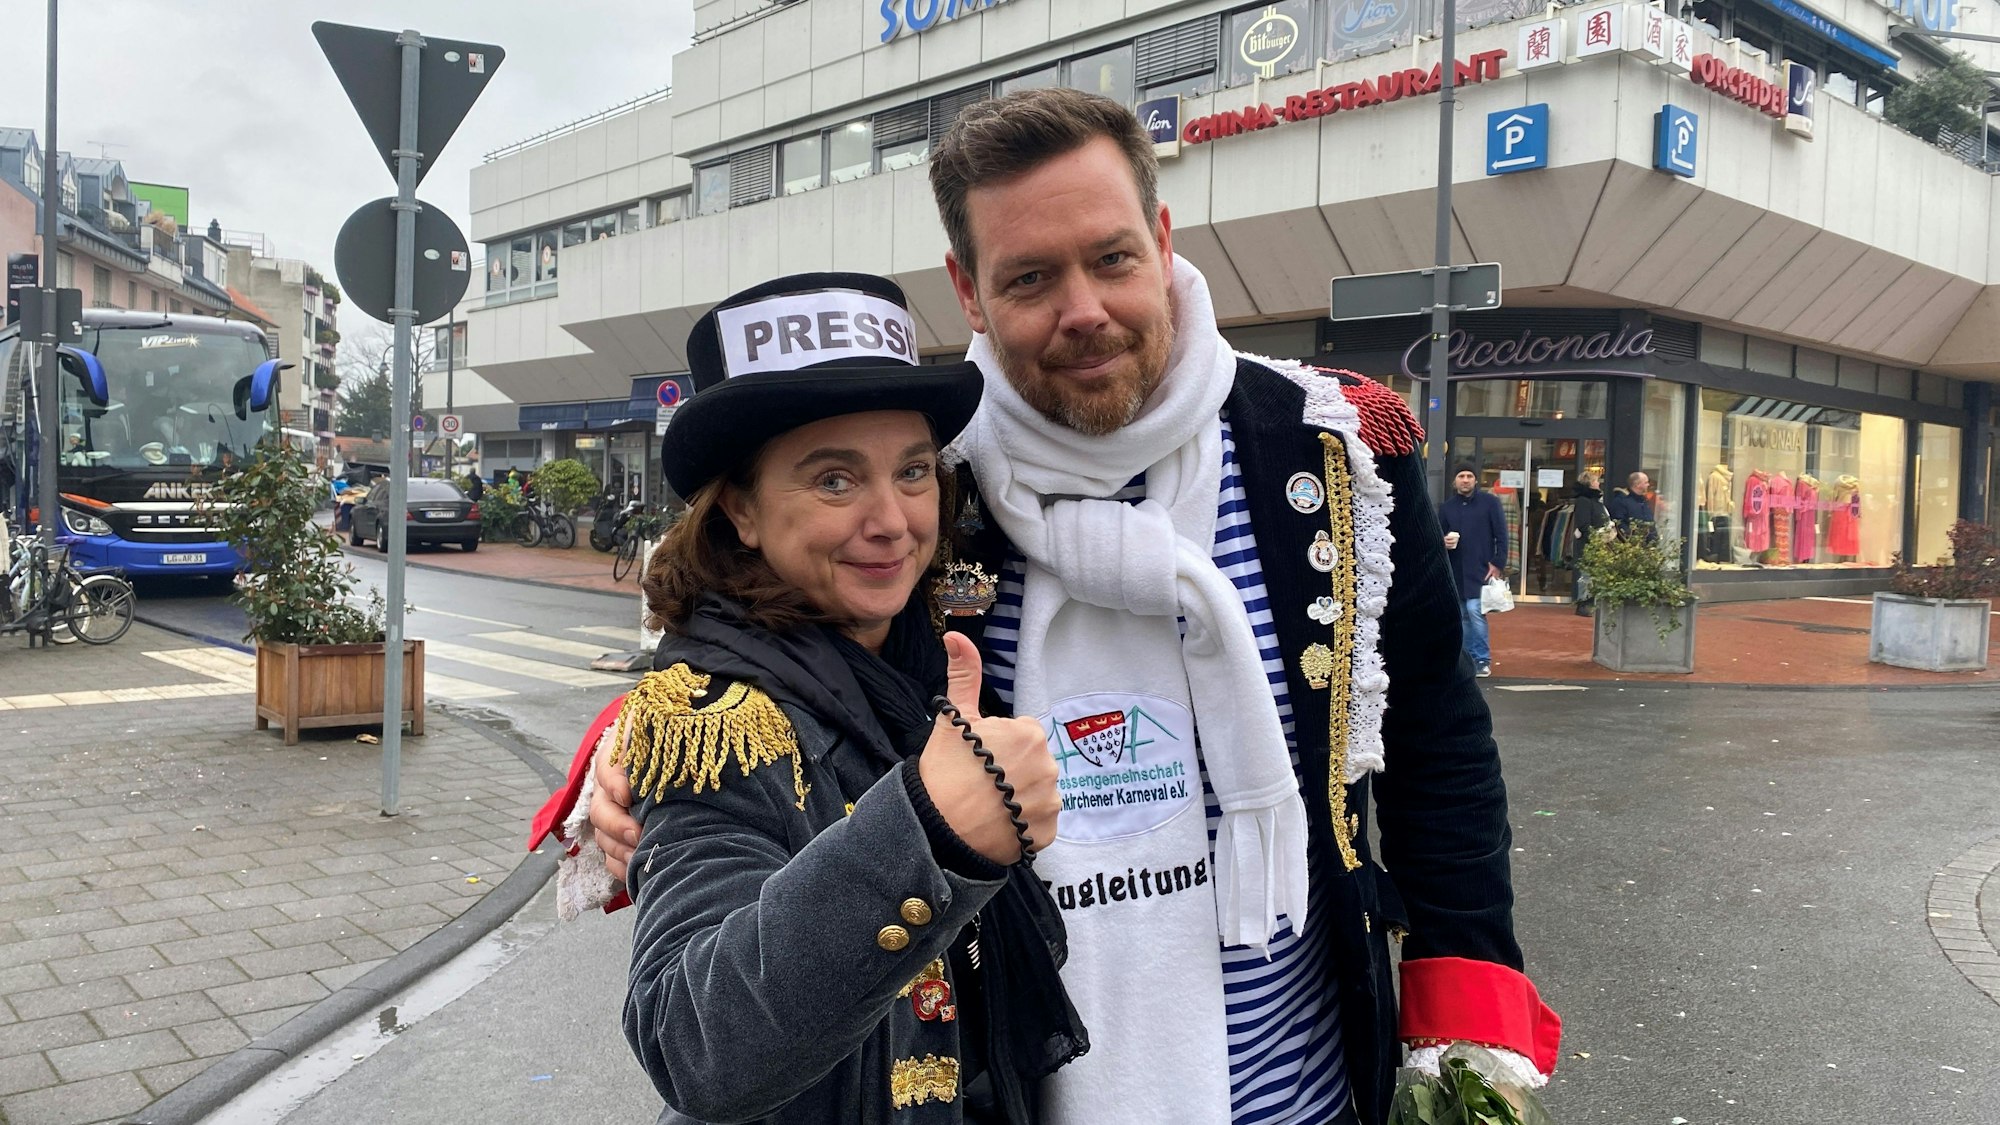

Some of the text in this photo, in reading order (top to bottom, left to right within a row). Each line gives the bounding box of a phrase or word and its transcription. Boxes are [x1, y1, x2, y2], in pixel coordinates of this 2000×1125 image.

[1183, 48, 1507, 144] CHINA-RESTAURANT
[1506, 126, 1525, 155] P
[445, 420, 456, 428] 30
[143, 482, 214, 499] ANKER
[1056, 761, 1185, 790] ressengemeinschaft
[1060, 790, 1114, 812] nkirchener
[1116, 783, 1168, 806] Karneval
[1043, 857, 1208, 910] ugleitung
